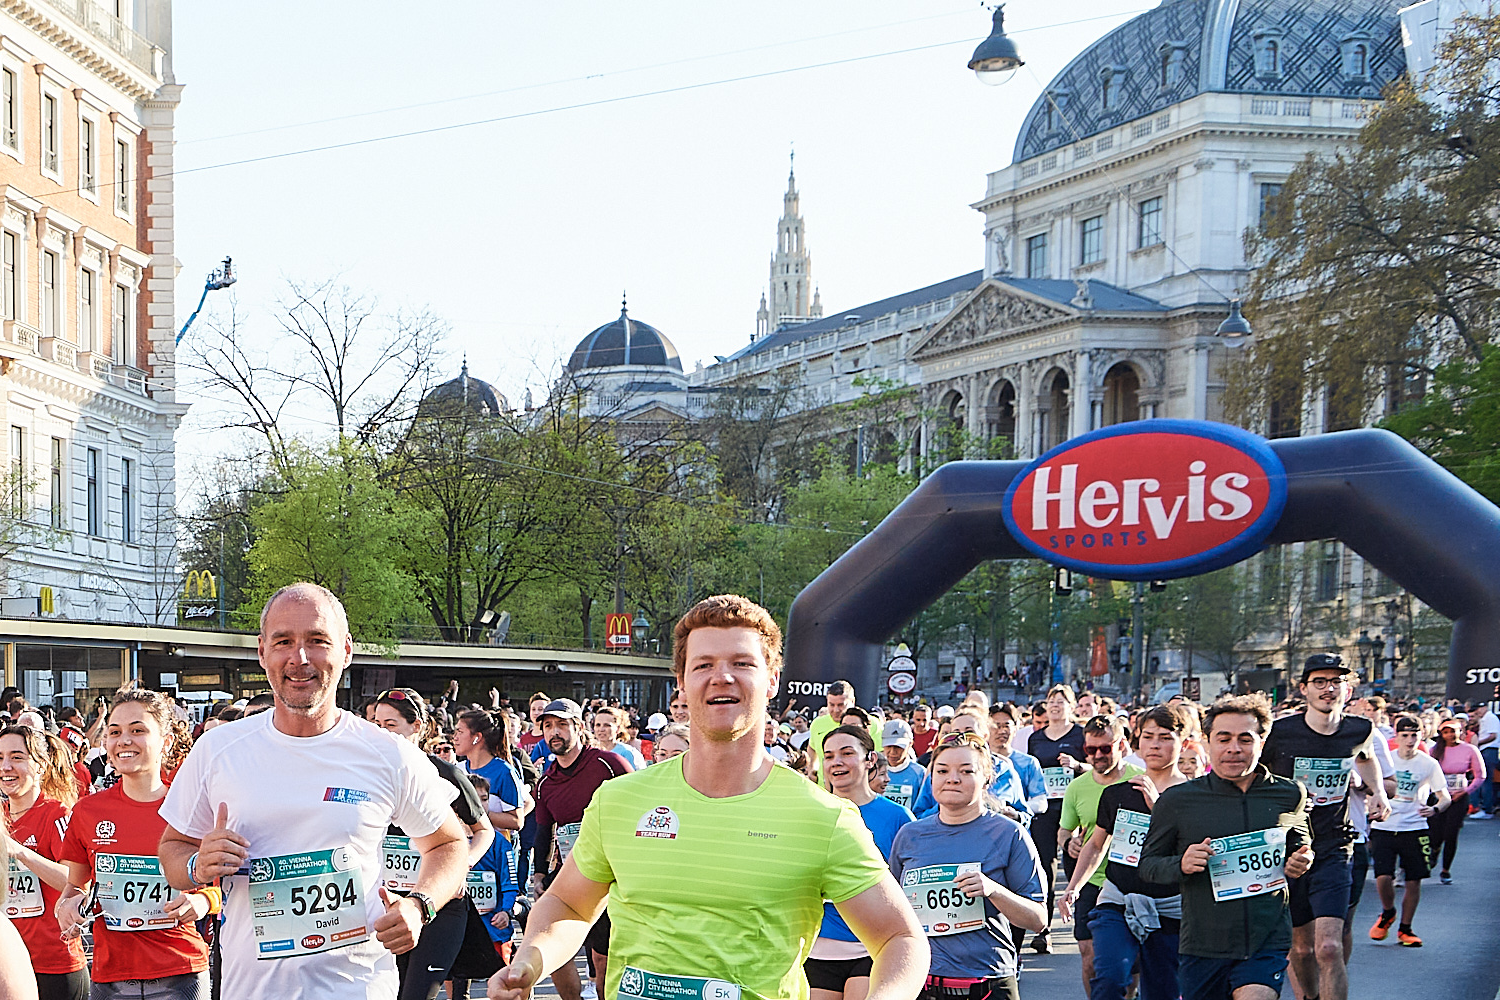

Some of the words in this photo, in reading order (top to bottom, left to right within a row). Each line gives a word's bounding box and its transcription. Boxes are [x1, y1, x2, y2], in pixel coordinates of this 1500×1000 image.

[1031, 460, 1253, 540] Hervis
[1050, 530, 1148, 549] SPORTS
[1316, 773, 1348, 788] 6339
[747, 830, 778, 839] benger
[288, 855, 312, 864] VIENNA
[293, 859, 328, 870] MARATHON
[385, 853, 421, 871] 5367
[1238, 848, 1281, 873] 5866
[123, 881, 172, 903] 6741
[291, 877, 358, 916] 5294
[315, 916, 340, 929] David
[302, 937, 324, 946] Hervis
[647, 983, 660, 991] CITY
[661, 985, 698, 996] MARATHON
[657, 979, 682, 988] VIENNA
[715, 988, 730, 999] 5K
